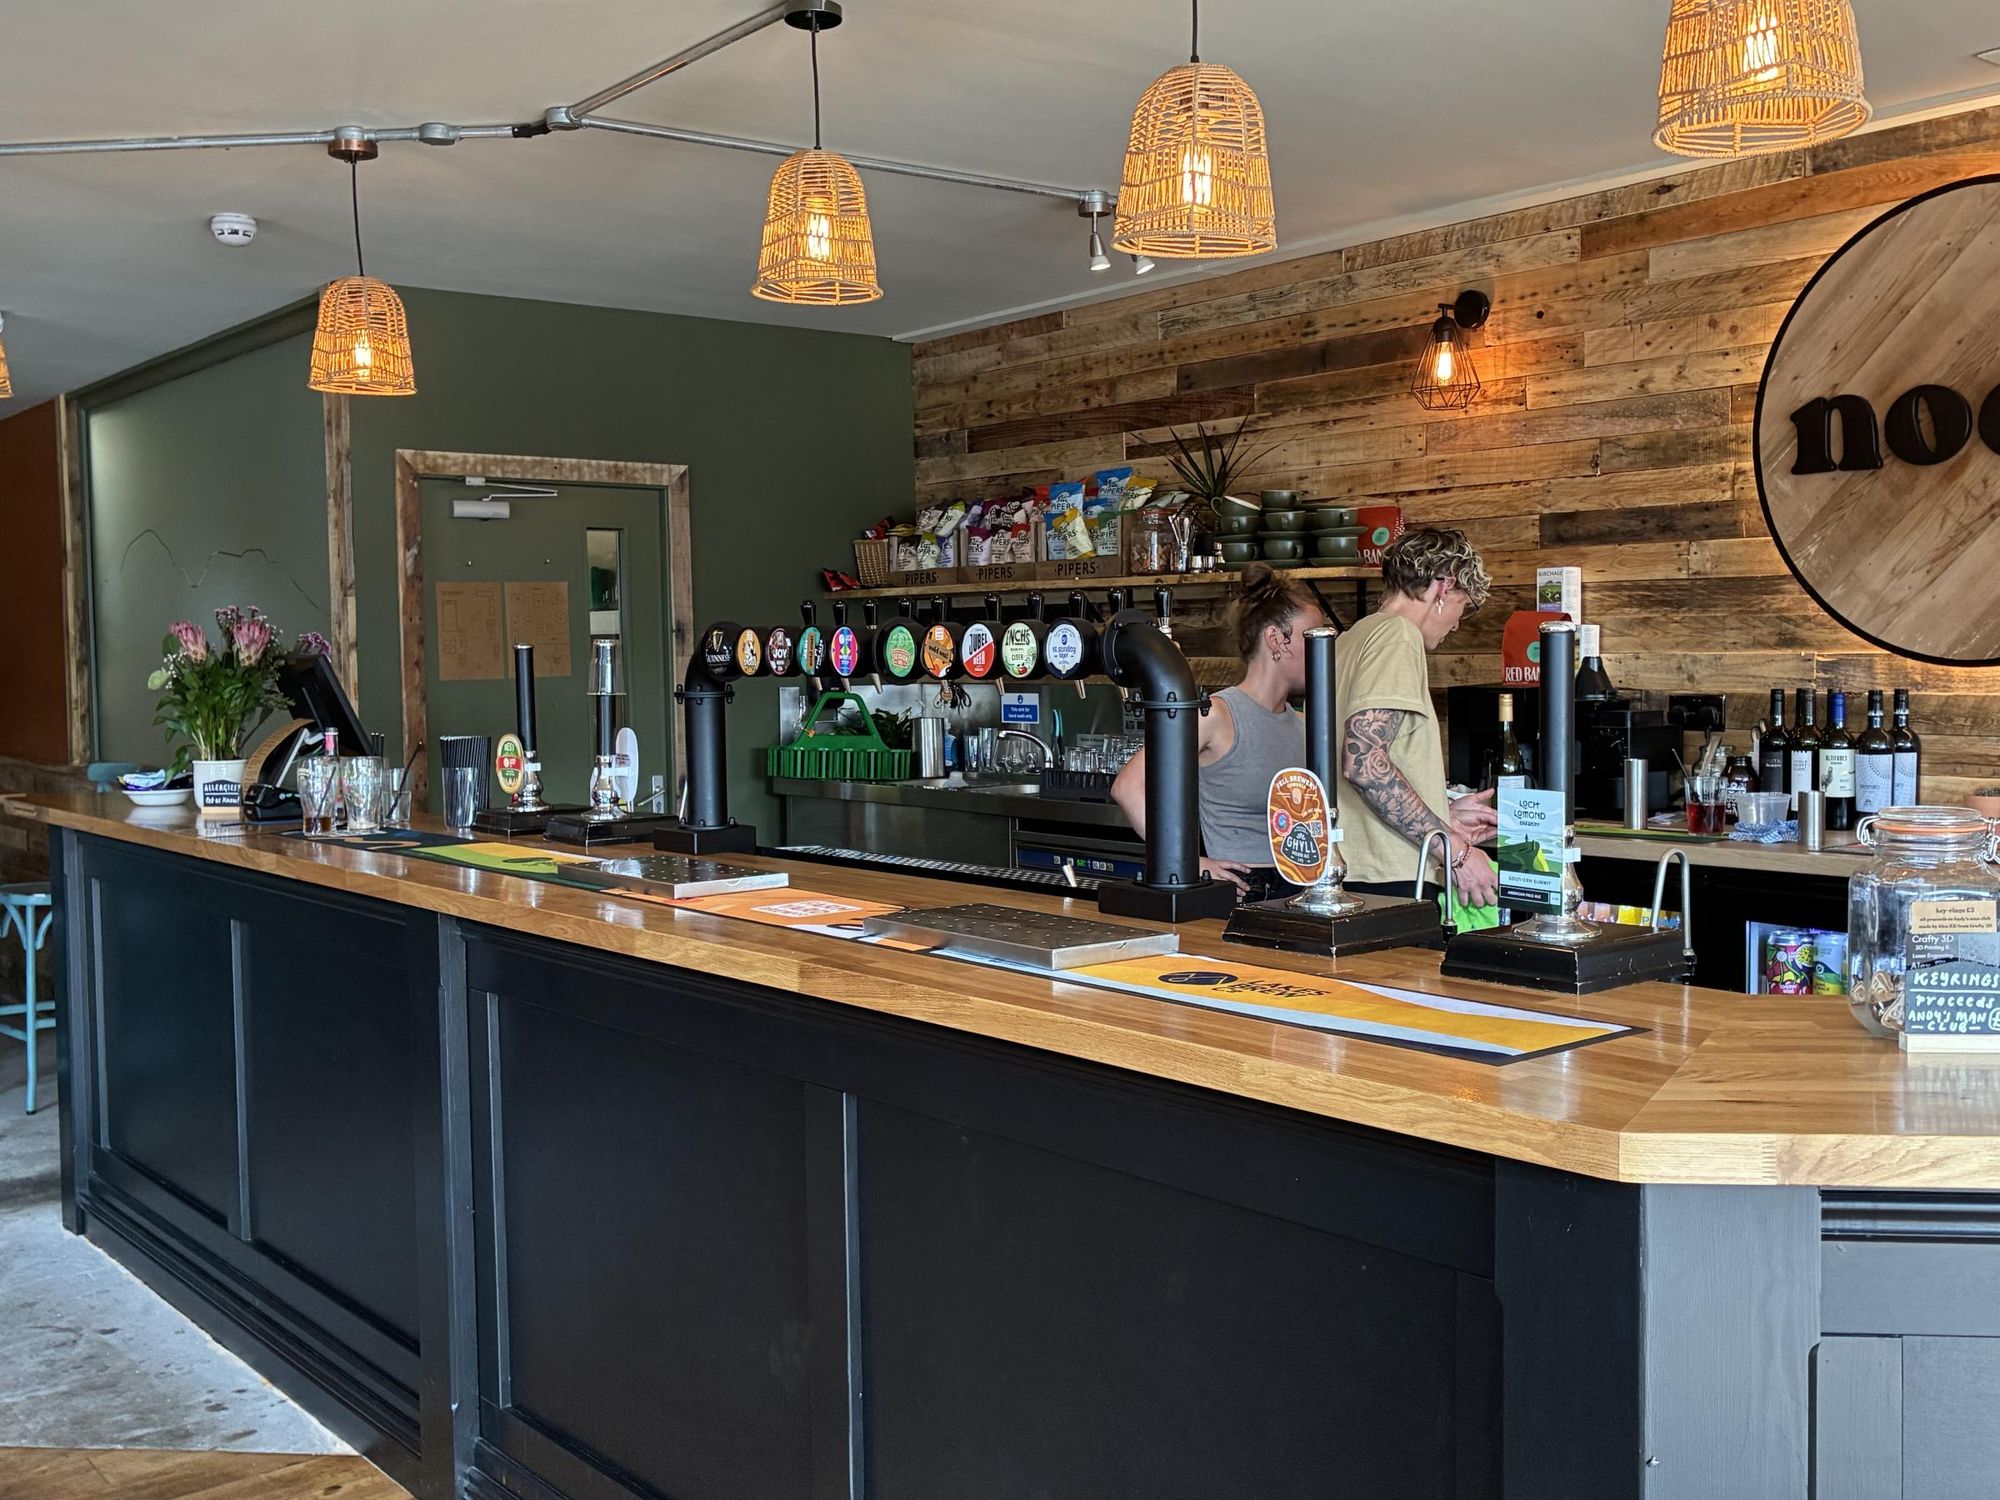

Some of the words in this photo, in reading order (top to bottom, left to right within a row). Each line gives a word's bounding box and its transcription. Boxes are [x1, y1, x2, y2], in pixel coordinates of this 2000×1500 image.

[1789, 383, 2000, 476] no
[772, 648, 787, 659] JOY
[1505, 666, 1522, 682] RED
[1286, 835, 1317, 853] GHYLL
[1911, 935, 1939, 944] Crafty
[1941, 935, 1954, 943] 3D
[1913, 971, 2000, 988] KEYRINGS
[1244, 979, 1331, 997] LAKES
[1955, 1011, 1987, 1024] MAN
